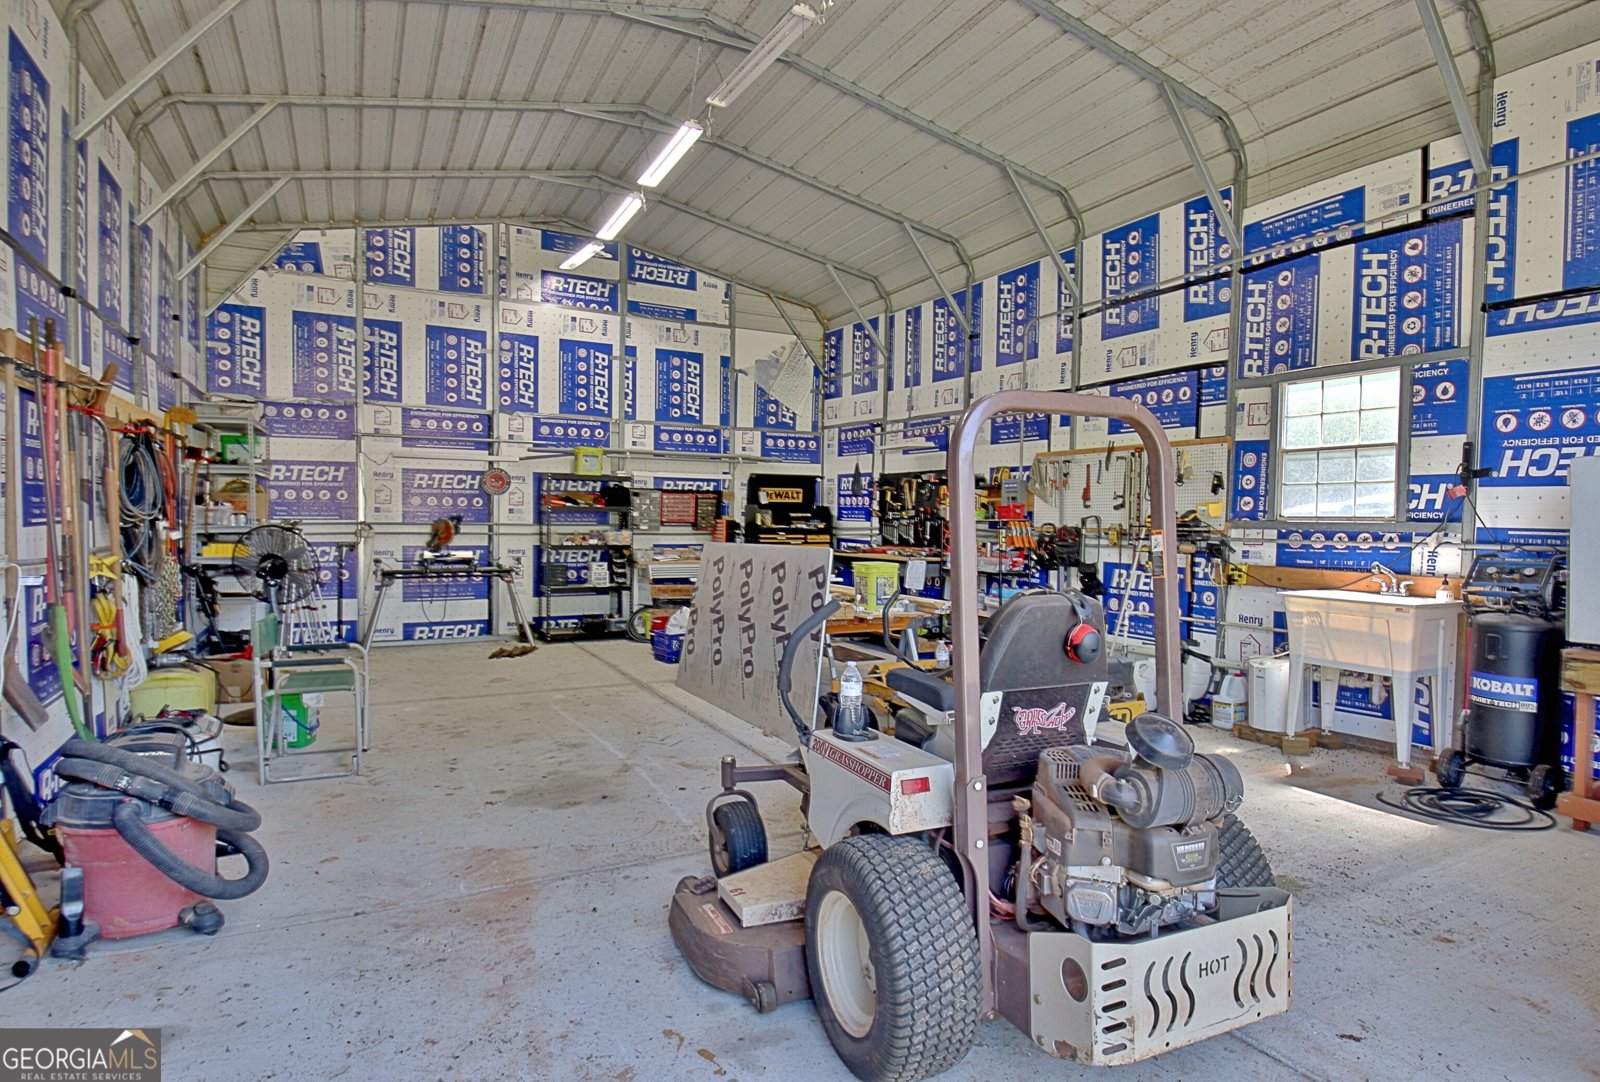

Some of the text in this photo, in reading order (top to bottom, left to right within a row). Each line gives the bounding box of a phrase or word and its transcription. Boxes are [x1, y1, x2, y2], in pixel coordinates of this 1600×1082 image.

[1494, 91, 1508, 128] Henry
[516, 272, 534, 280] Henry
[634, 265, 688, 286] R-TECH
[1190, 213, 1208, 304] RTECH
[550, 276, 610, 298] R-TECH
[1106, 242, 1120, 324] RTECH
[1000, 284, 1012, 354] R-TECH
[1360, 252, 1387, 359] R-TECH
[1387, 250, 1398, 357] NGINEERED FOR EFFICIENCY
[935, 308, 944, 371] R-TECH
[1190, 332, 1198, 358] Henry
[1244, 284, 1266, 377] R-TECH
[242, 316, 260, 388] R-TECH
[338, 326, 356, 393] R-TECH
[380, 330, 398, 398] R-TECH
[466, 339, 482, 404] R-TECH
[520, 344, 534, 406] R-TECH
[595, 352, 608, 412] R-TECH
[688, 360, 700, 418] R-TECH
[1117, 384, 1145, 392] ENGINEERED
[1159, 375, 1188, 386] EFFICIENCY
[1414, 368, 1449, 378] ICIENCY
[1502, 437, 1559, 446] EFFICIENCY
[270, 464, 345, 481] R-TECH
[413, 474, 480, 489] R-TECH
[1258, 452, 1267, 496] ENGINEERED
[767, 490, 802, 500] EWALT
[1426, 550, 1438, 577] Henr
[710, 556, 724, 666] PolyPro
[738, 558, 756, 678] PolyPro
[1238, 614, 1263, 626] Henry
[414, 624, 480, 640] R-TECH
[1471, 695, 1519, 708] QUIET TECH
[1472, 677, 1534, 696] KOBALT
[830, 748, 886, 787] GRASSHOPPER
[1199, 955, 1229, 978] HOT
